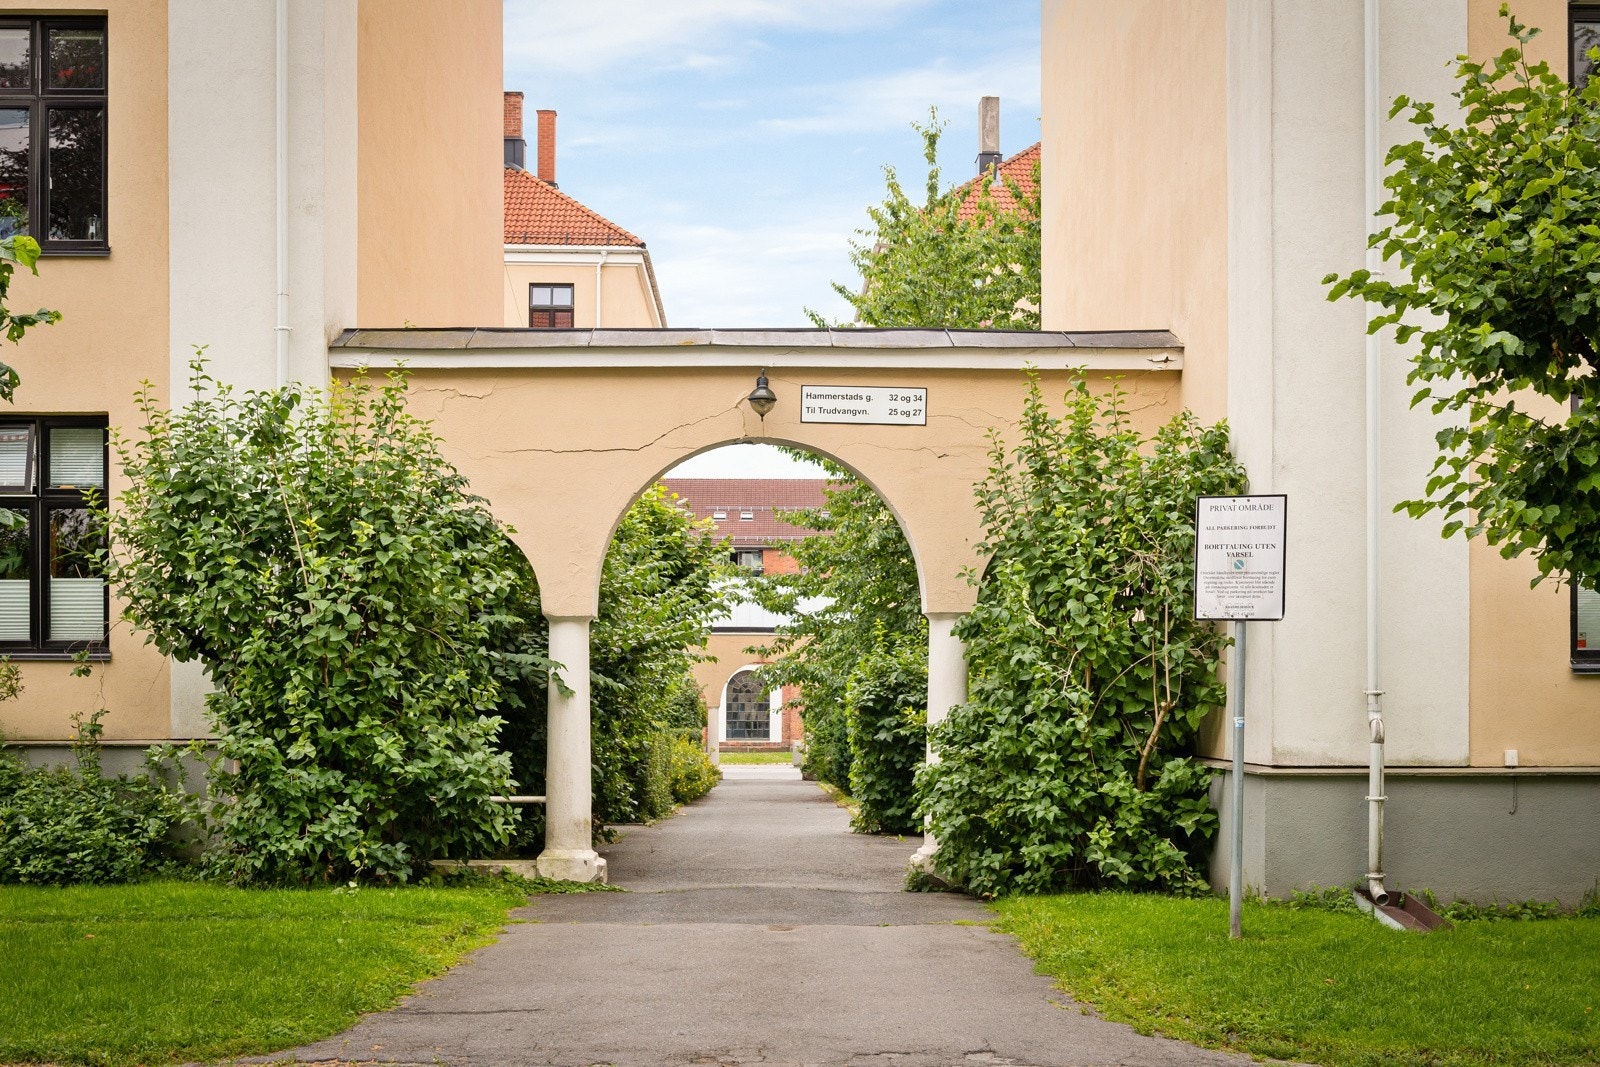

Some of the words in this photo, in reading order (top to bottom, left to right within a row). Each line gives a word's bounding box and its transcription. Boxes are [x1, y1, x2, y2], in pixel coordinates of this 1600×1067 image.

[806, 392, 863, 401] Hammerstads
[866, 394, 874, 403] g.
[818, 407, 870, 416] Trudvangvn.
[1238, 503, 1274, 511] OMRÅDE
